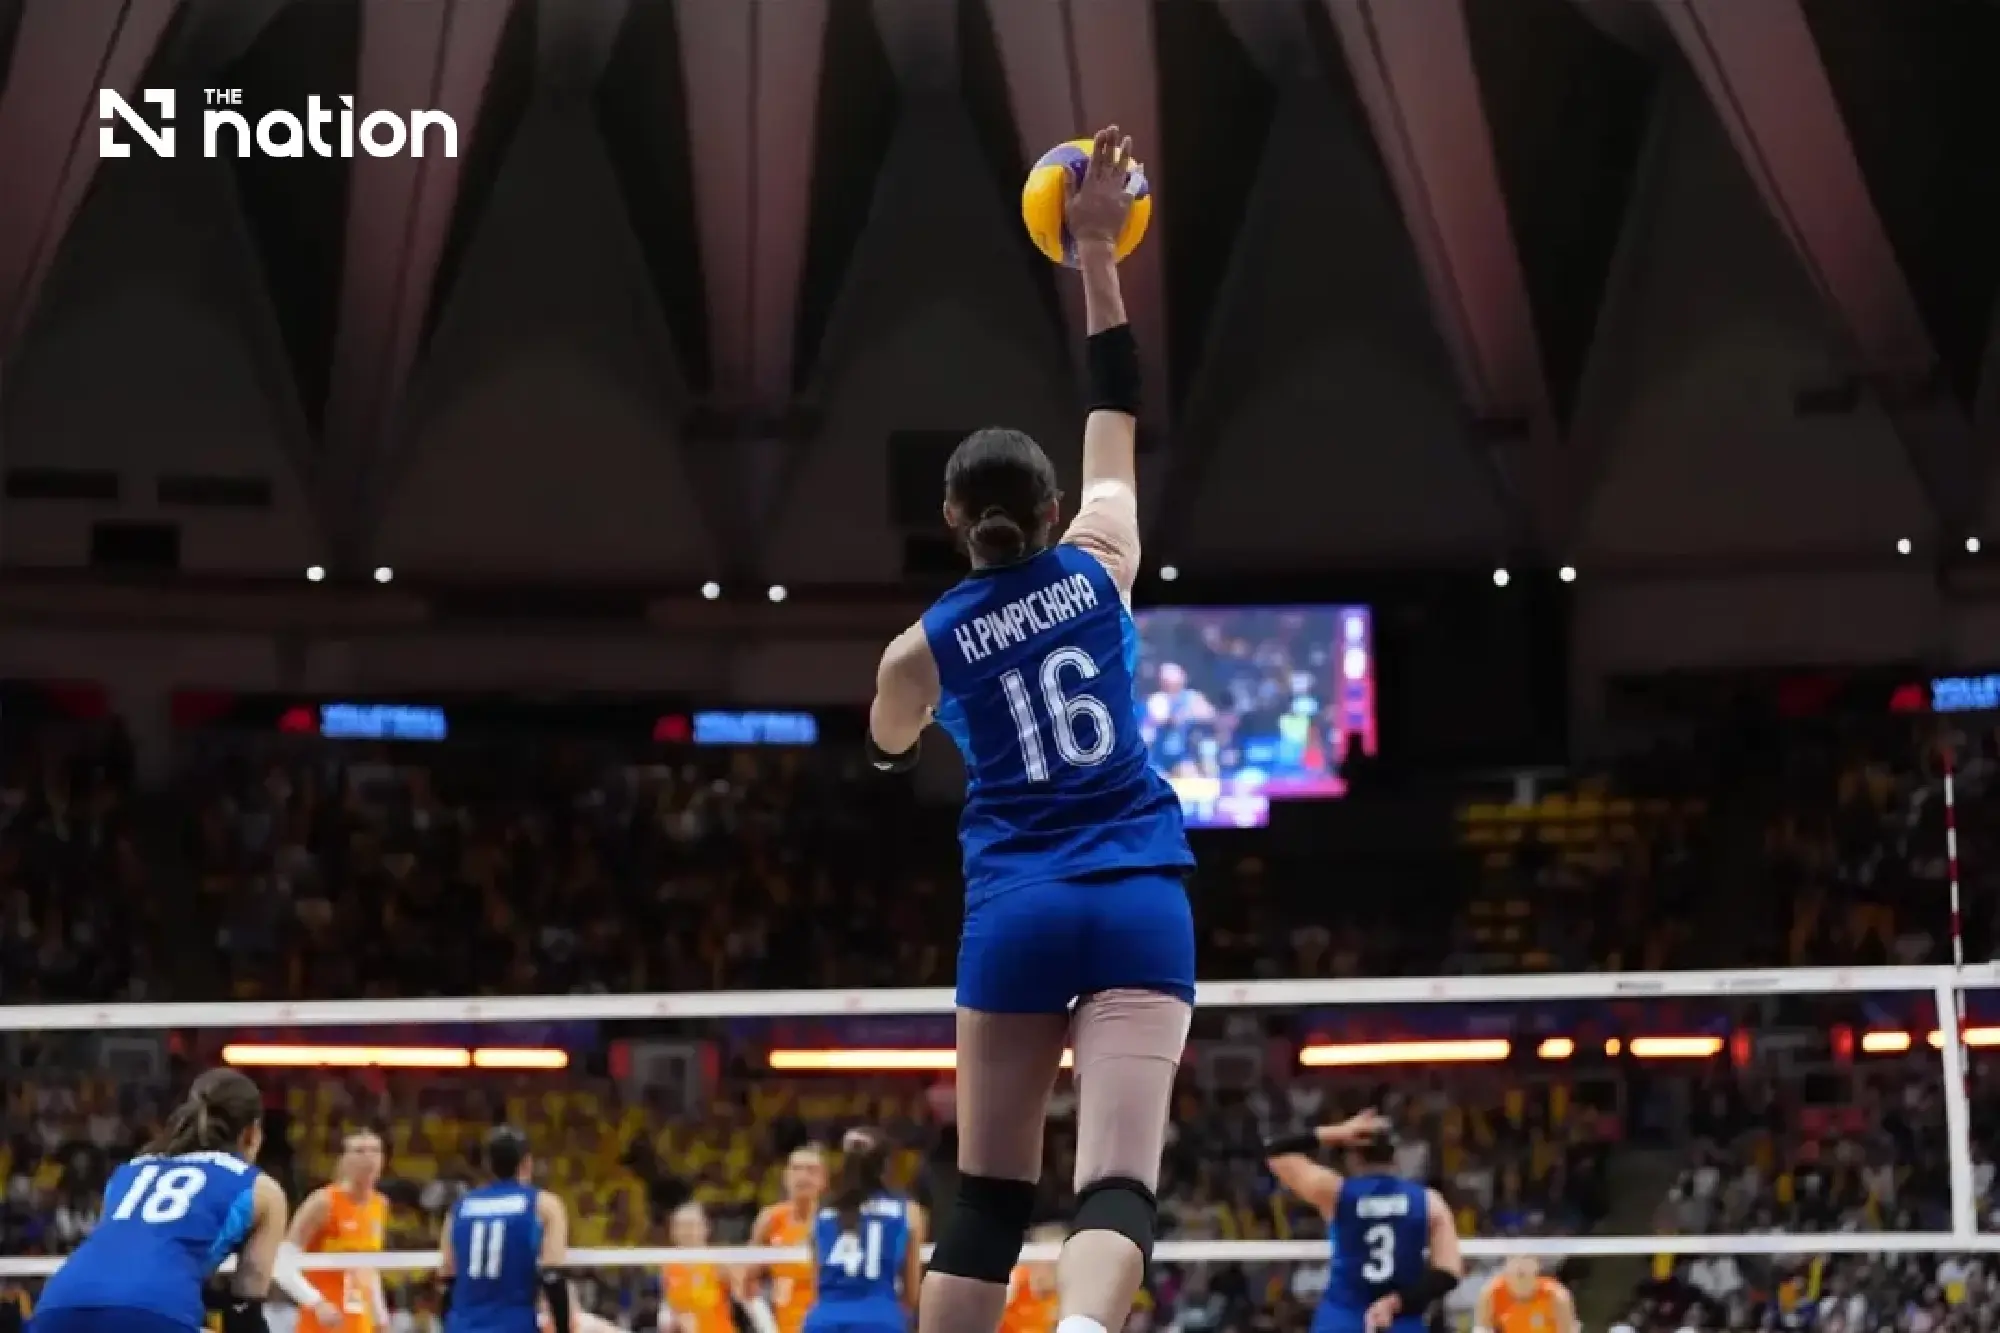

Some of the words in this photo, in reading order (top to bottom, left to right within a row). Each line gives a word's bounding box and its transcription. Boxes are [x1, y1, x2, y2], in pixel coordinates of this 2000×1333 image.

[954, 573, 1099, 664] H.PIMPICHAYA
[999, 646, 1116, 784] 16
[111, 1164, 208, 1223] 18
[468, 1219, 506, 1279] 11
[826, 1220, 882, 1280] 41
[1361, 1223, 1395, 1283] 3
